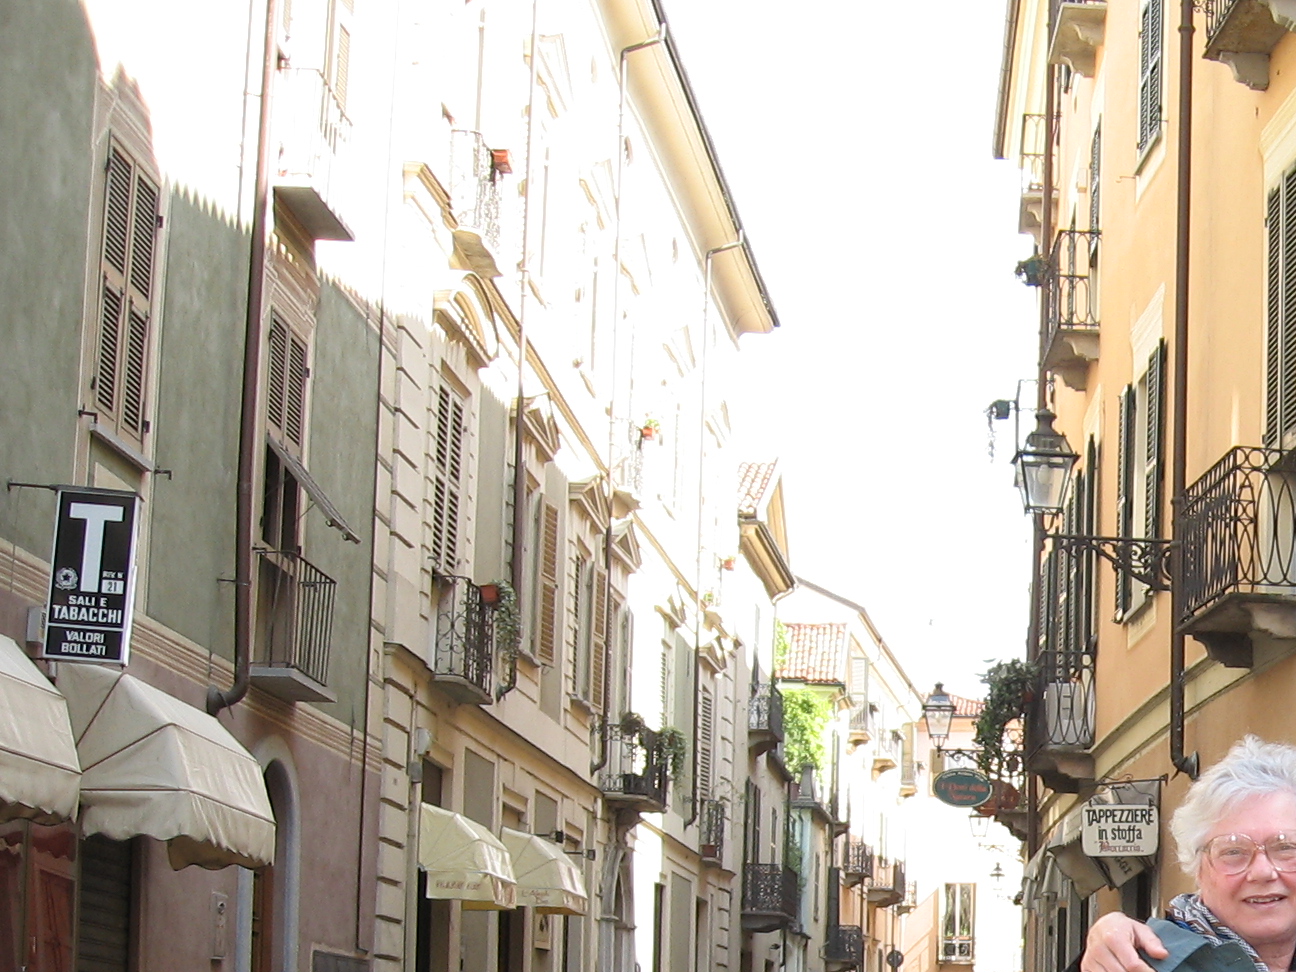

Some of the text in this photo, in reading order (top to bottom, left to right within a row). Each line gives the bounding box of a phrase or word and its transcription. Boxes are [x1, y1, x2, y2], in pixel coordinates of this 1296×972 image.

[69, 502, 124, 593] T
[107, 581, 117, 592] 21
[68, 595, 108, 607] SALI E
[52, 604, 122, 624] TABACCHI
[65, 630, 104, 643] VALORI
[61, 642, 106, 656] BOLLATI
[1085, 808, 1155, 826] TAPPEZZIERE
[1098, 824, 1143, 843] in stoffa
